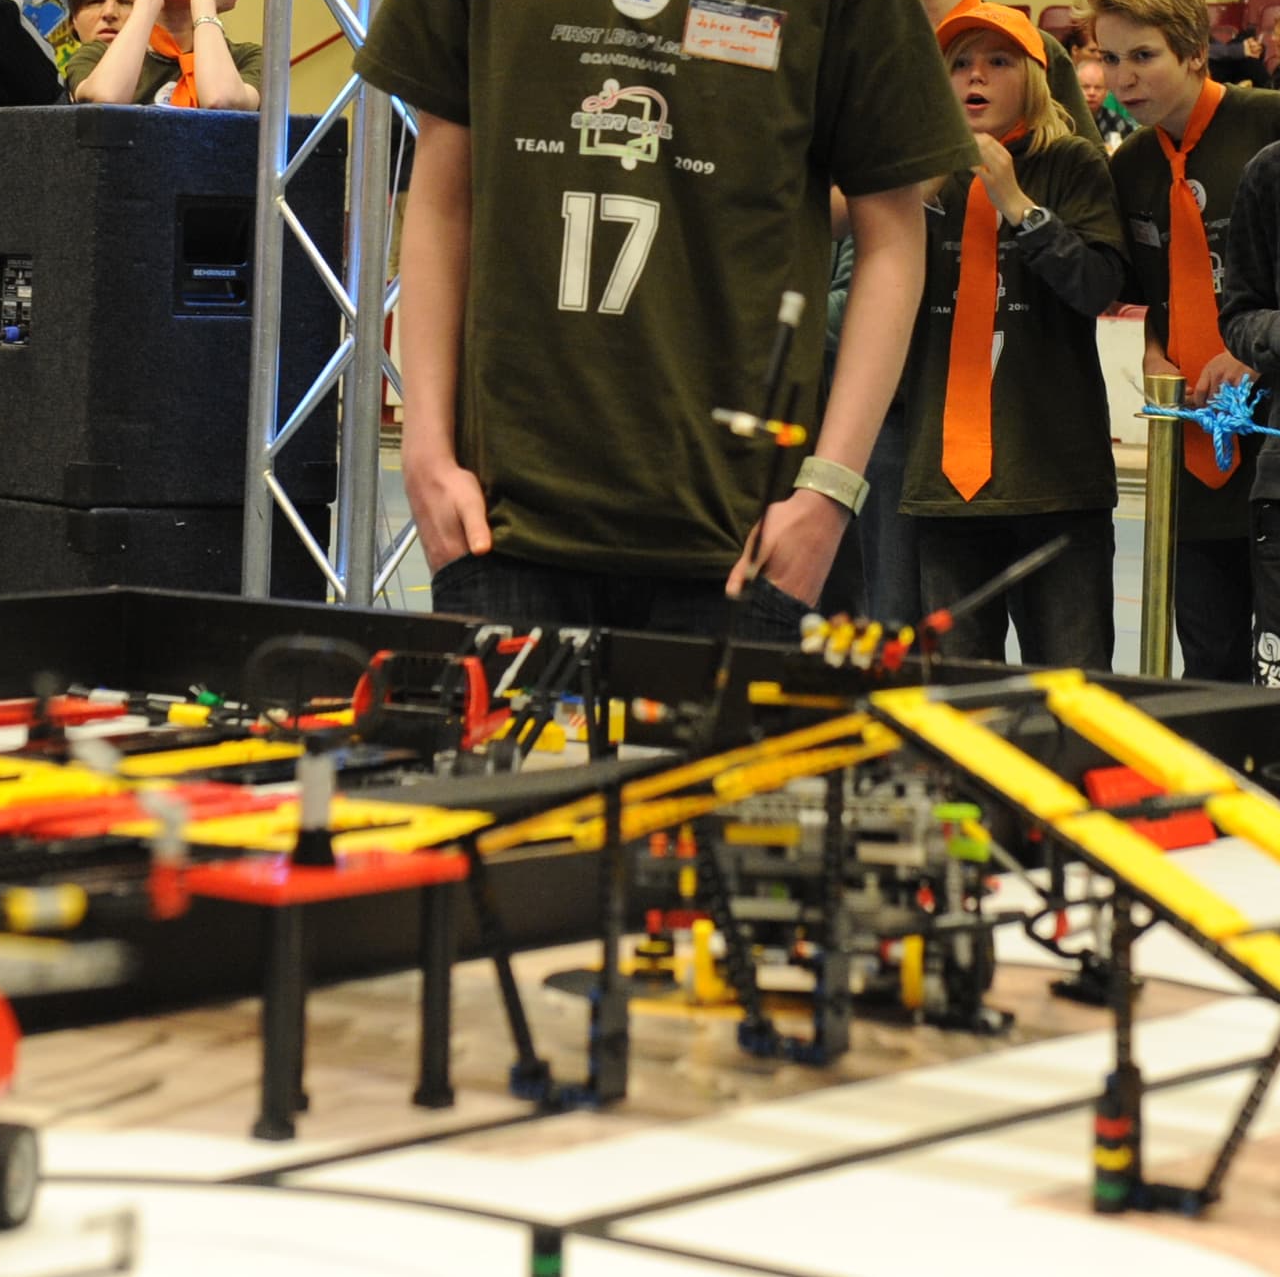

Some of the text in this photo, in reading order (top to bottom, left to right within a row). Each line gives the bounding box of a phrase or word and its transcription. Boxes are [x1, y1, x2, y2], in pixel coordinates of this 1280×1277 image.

[551, 24, 606, 44] FIRST
[514, 137, 716, 175] TEAM 2009
[558, 190, 660, 314] 17
